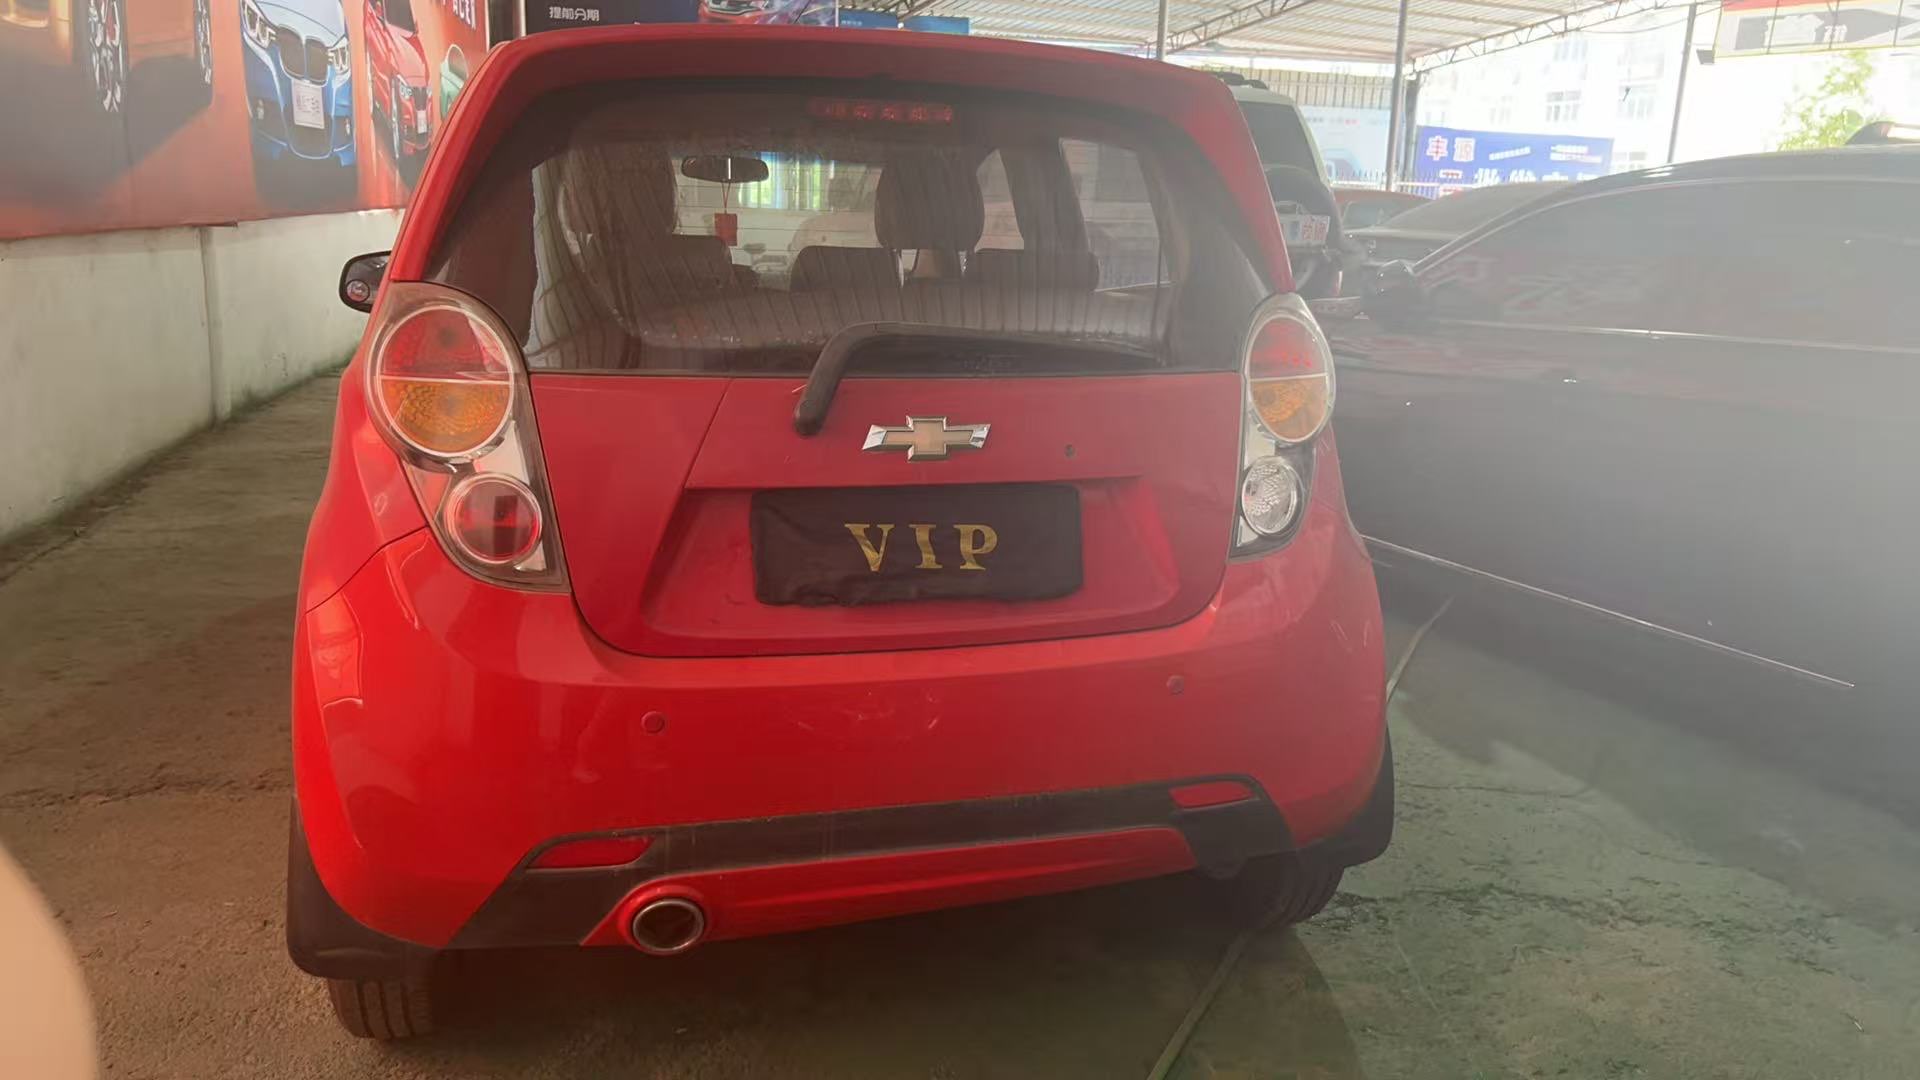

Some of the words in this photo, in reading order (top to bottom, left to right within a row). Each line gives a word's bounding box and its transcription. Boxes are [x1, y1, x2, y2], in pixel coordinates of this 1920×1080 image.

[549, 6, 601, 22] 提前分期
[844, 523, 998, 571] VIP
